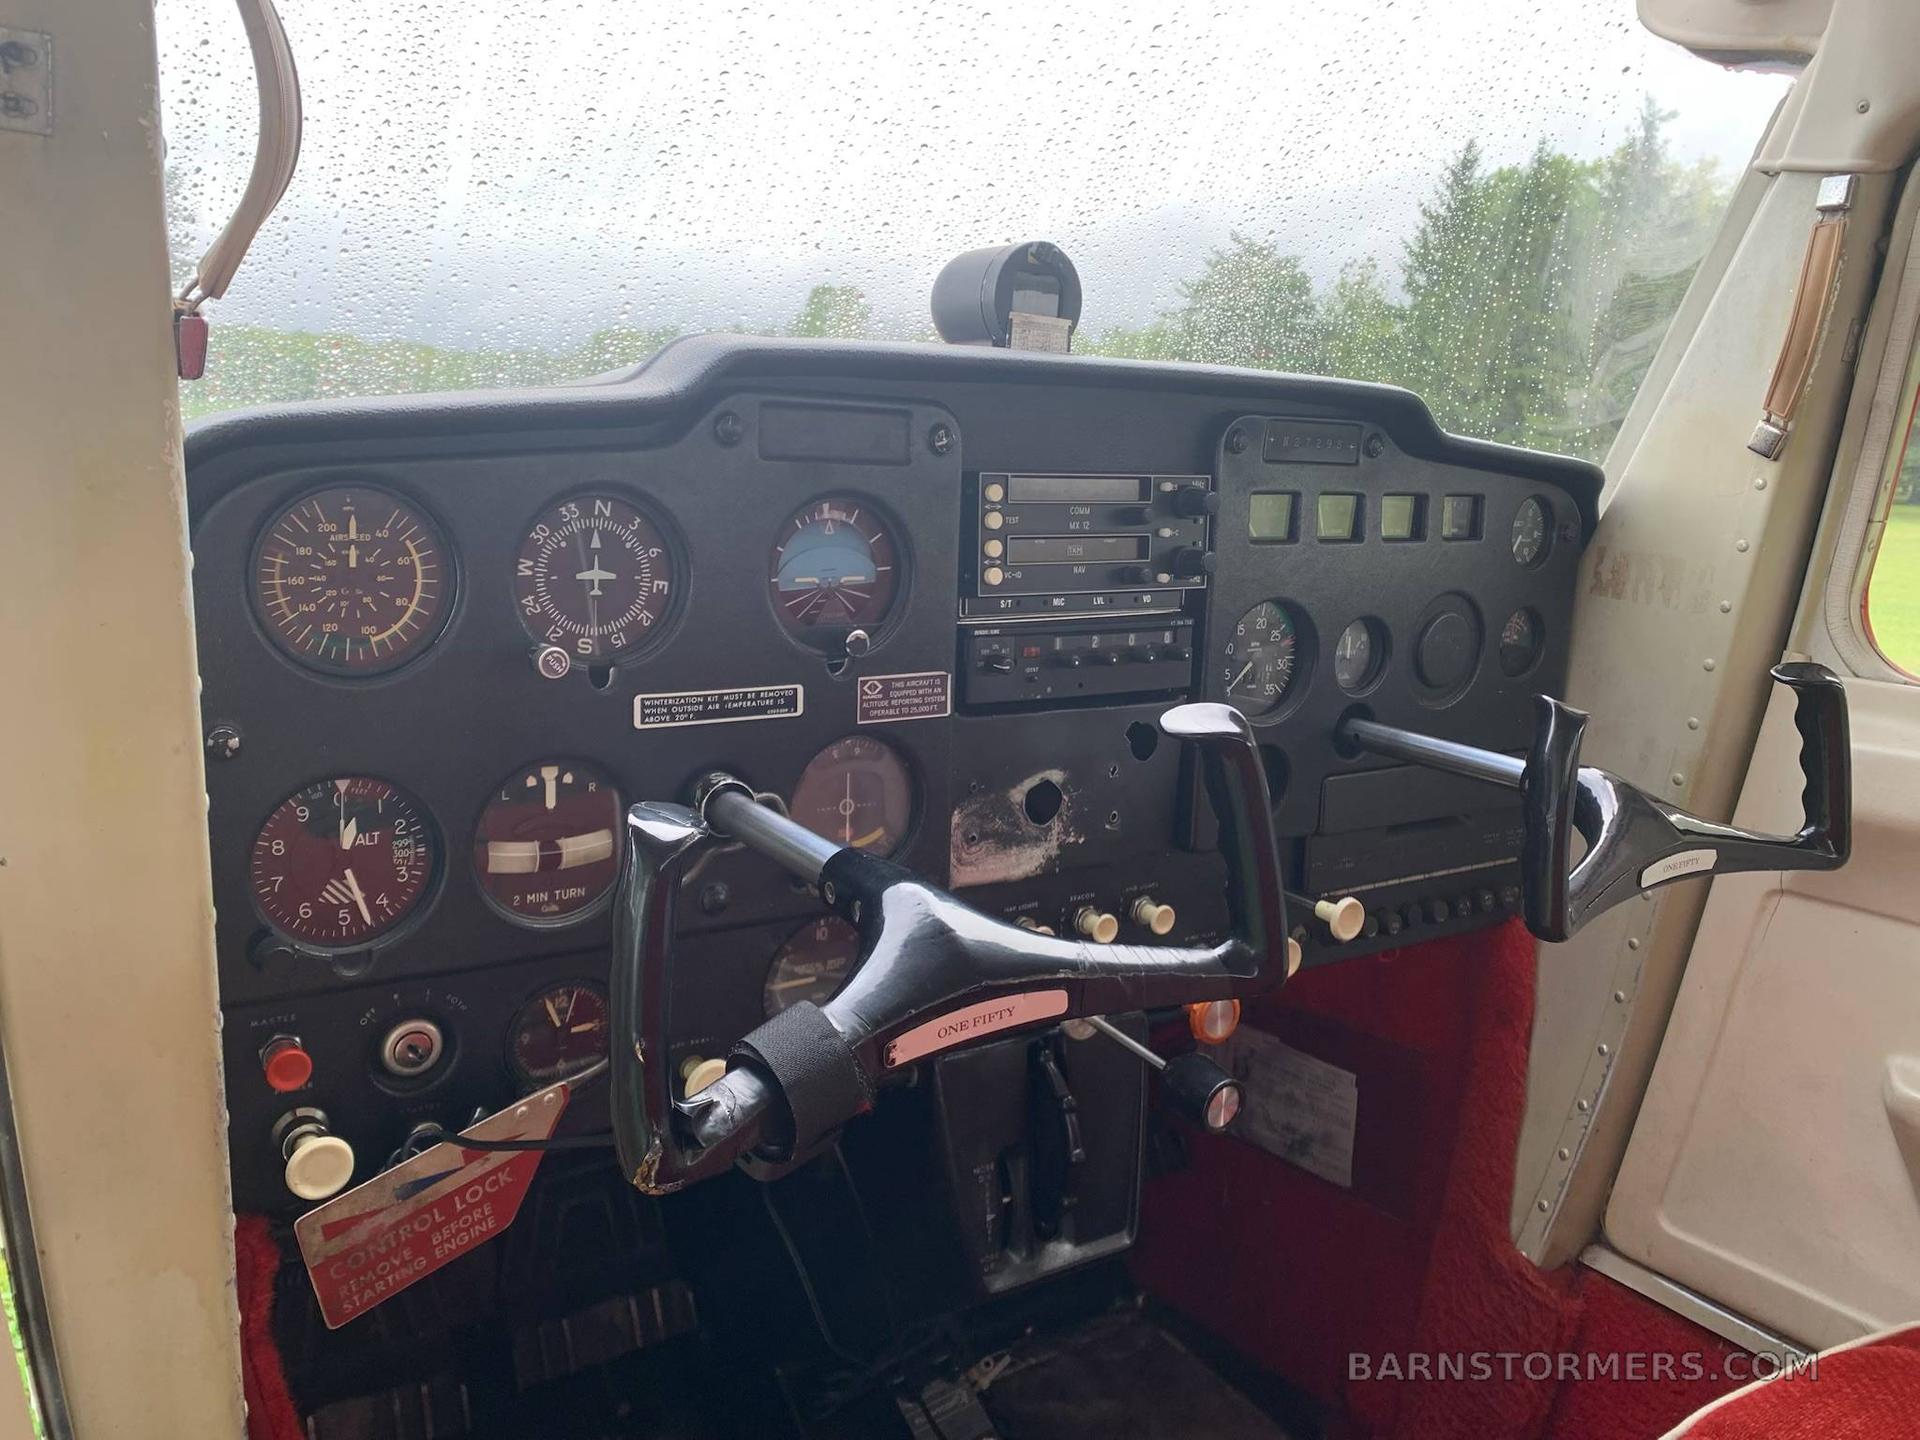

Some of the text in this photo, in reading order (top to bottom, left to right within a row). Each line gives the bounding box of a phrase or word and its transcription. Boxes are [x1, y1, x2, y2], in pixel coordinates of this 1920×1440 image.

[559, 503, 580, 522] 33
[594, 499, 612, 517] N
[1069, 506, 1090, 515] COMM
[318, 523, 337, 533] 200
[629, 517, 641, 530] 3
[1069, 521, 1090, 530] MX 12
[330, 533, 372, 542] AIRSEED
[375, 529, 389, 538] 40
[529, 523, 550, 545] 30
[296, 547, 312, 556] 180
[649, 547, 663, 558] 6
[397, 556, 410, 566] 60
[517, 558, 534, 576] W
[1073, 566, 1087, 574] NAV
[287, 576, 305, 585] 160
[652, 579, 669, 594] E
[298, 603, 316, 612] 140
[395, 597, 408, 607] 80
[521, 595, 541, 616] 24
[1000, 599, 1012, 608] S/T
[1053, 598, 1065, 606] MIC
[1093, 596, 1105, 605] LVL
[637, 610, 654, 626] 12
[1256, 618, 1267, 630] 20
[322, 623, 338, 632] 120
[361, 625, 377, 634] 100
[545, 624, 563, 642] 21
[1237, 624, 1246, 636] 15
[611, 631, 626, 648] 15
[1092, 635, 1098, 648] 2
[1128, 634, 1135, 646] 0
[1270, 630, 1280, 641] 25
[577, 638, 593, 654] S
[545, 655, 564, 673] PUSH
[1276, 659, 1288, 670] 30
[1224, 669, 1231, 680] 5
[1264, 684, 1275, 695] 35
[643, 697, 704, 706] WINTERIZATION
[760, 690, 794, 699] REMOVED
[862, 701, 889, 709] ALTITUDE
[891, 697, 923, 706] REPORTING
[924, 695, 946, 703] SYSTEM
[644, 707, 667, 715] WHEN
[671, 704, 703, 713] OUTSIDE
[869, 708, 900, 717] OPERABLE
[644, 715, 671, 723] ABOVE
[588, 782, 597, 793] R
[502, 790, 510, 801] L
[296, 805, 310, 823] 9
[394, 819, 408, 835] 2
[355, 832, 380, 847] ALT
[271, 839, 285, 856] 8
[1664, 856, 1700, 873] ONE FIFTY
[396, 866, 409, 882] 3
[270, 876, 284, 893] 7
[376, 893, 389, 908] 4
[513, 887, 586, 906] 2 MIN TURN
[298, 902, 313, 919] 6
[338, 908, 351, 926] 5
[816, 927, 828, 941] 10
[937, 1005, 1016, 1039] ONE FIFTY
[330, 1167, 515, 1280] CONTROL LOCK
[338, 1202, 494, 1299] REMOVE BEFORE
[342, 1216, 498, 1314] STARTING ENGINE
